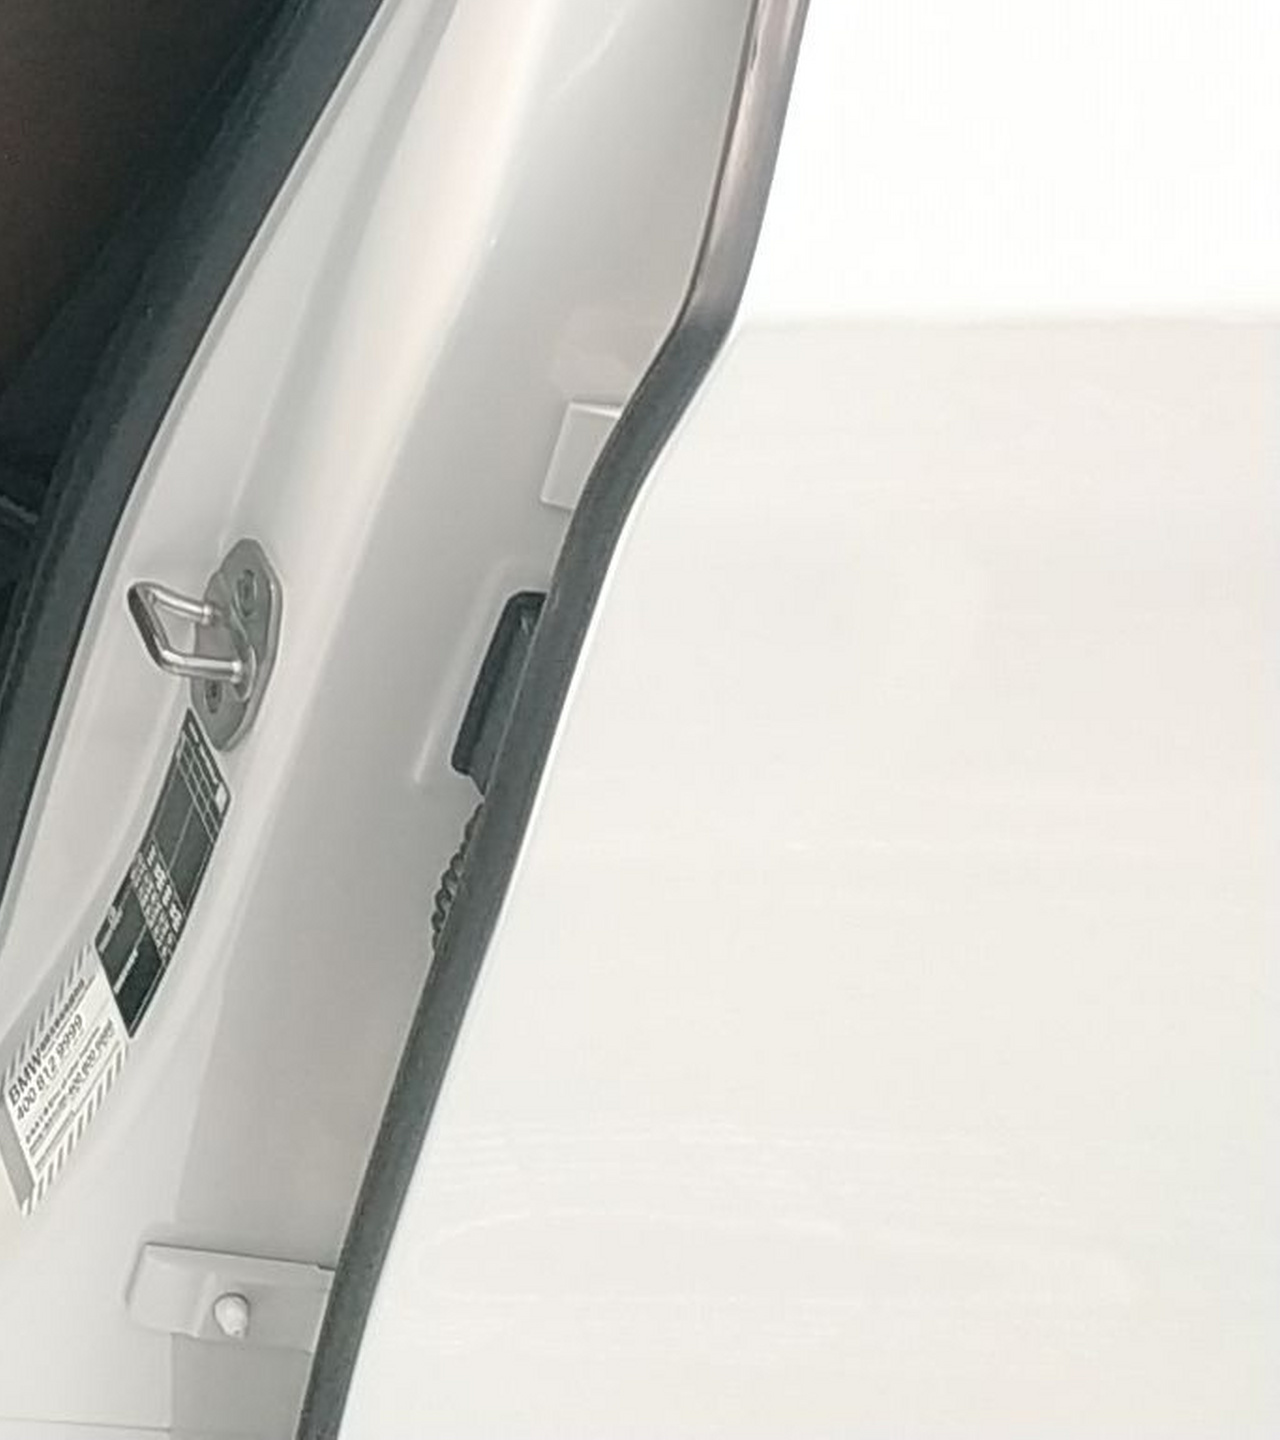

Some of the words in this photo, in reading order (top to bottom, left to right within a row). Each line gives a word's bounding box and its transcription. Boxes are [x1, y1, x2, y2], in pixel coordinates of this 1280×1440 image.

[8, 1047, 42, 1107] BMW
[16, 1086, 37, 1121] 400
[38, 1056, 59, 1091] 812
